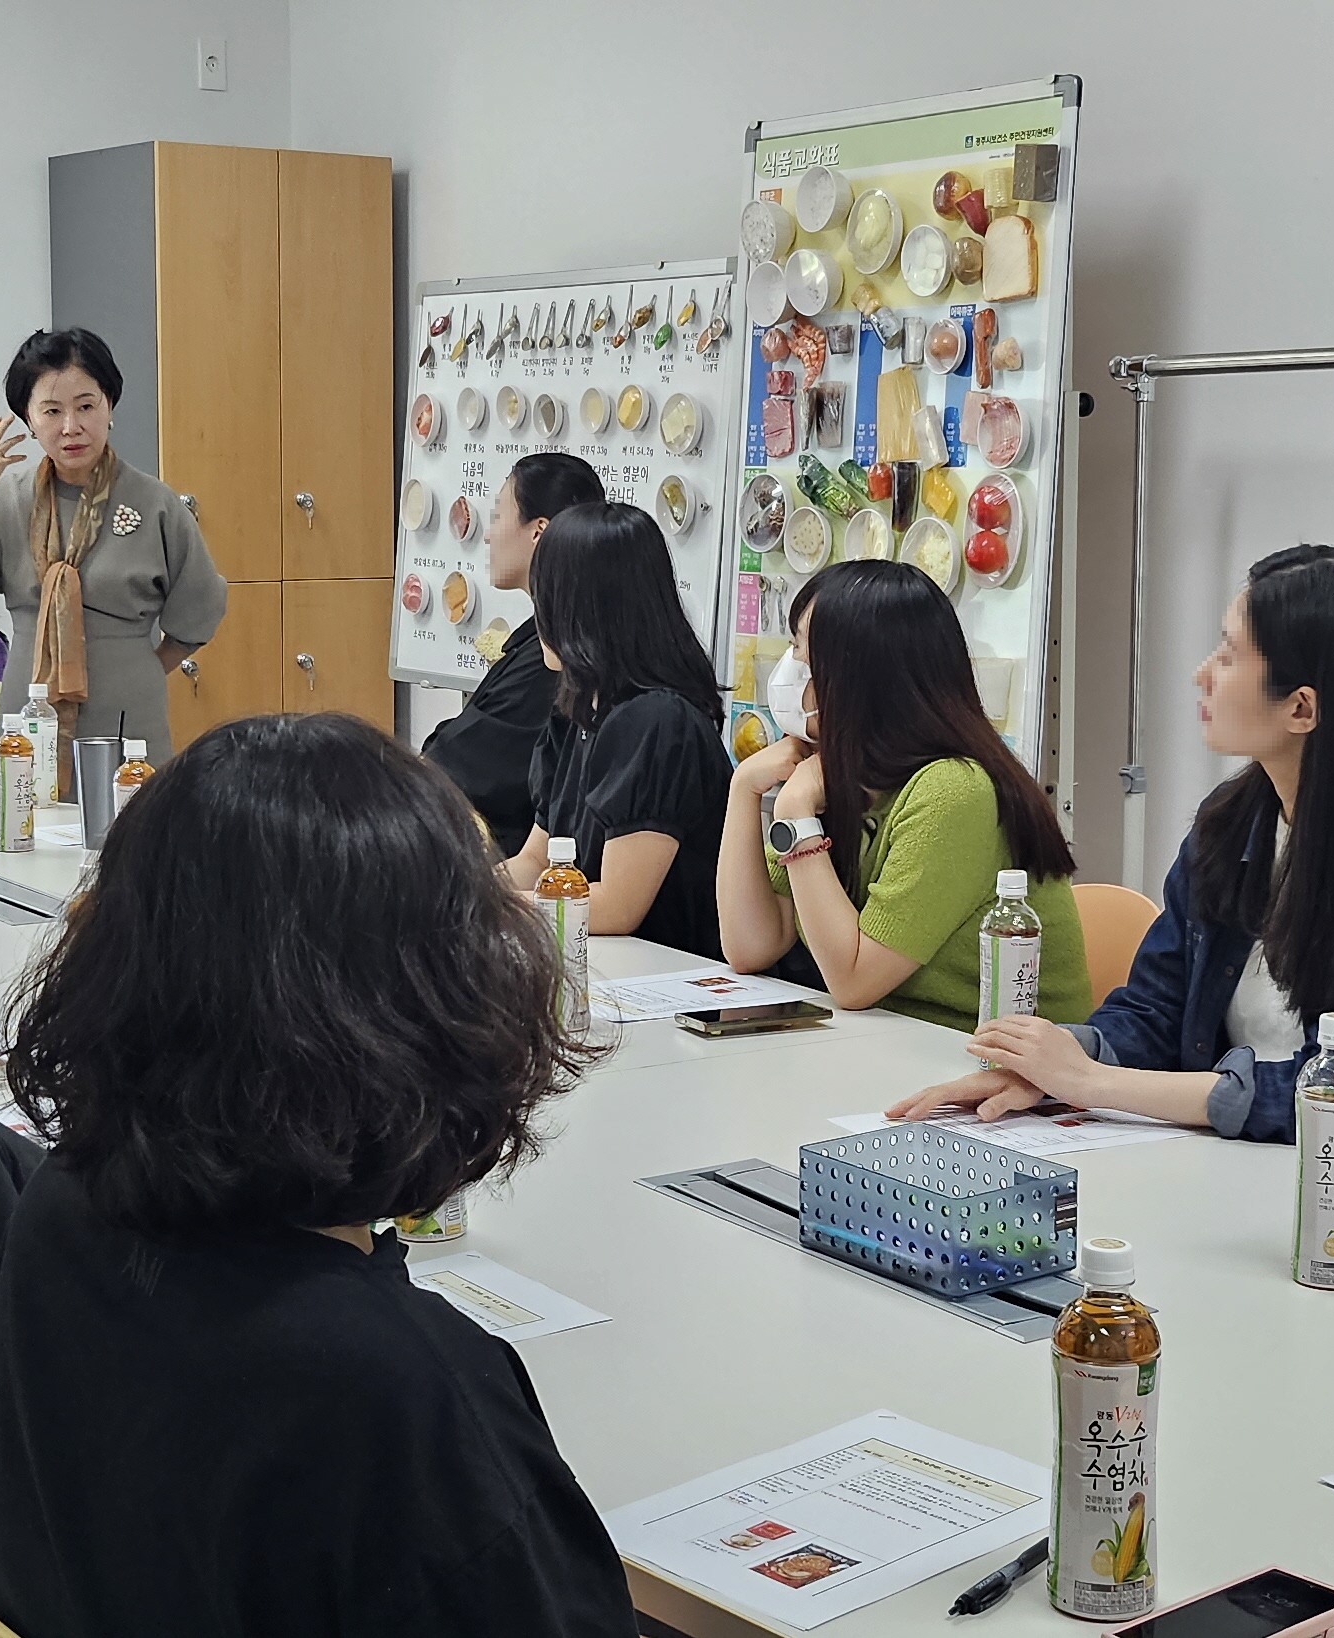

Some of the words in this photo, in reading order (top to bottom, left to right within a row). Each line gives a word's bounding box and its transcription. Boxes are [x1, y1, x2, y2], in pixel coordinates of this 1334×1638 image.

[462, 461, 485, 477] 다음의
[460, 480, 490, 498] 식품에는
[1079, 1420, 1149, 1461] 옥수수
[1081, 1459, 1146, 1492] 수염차
